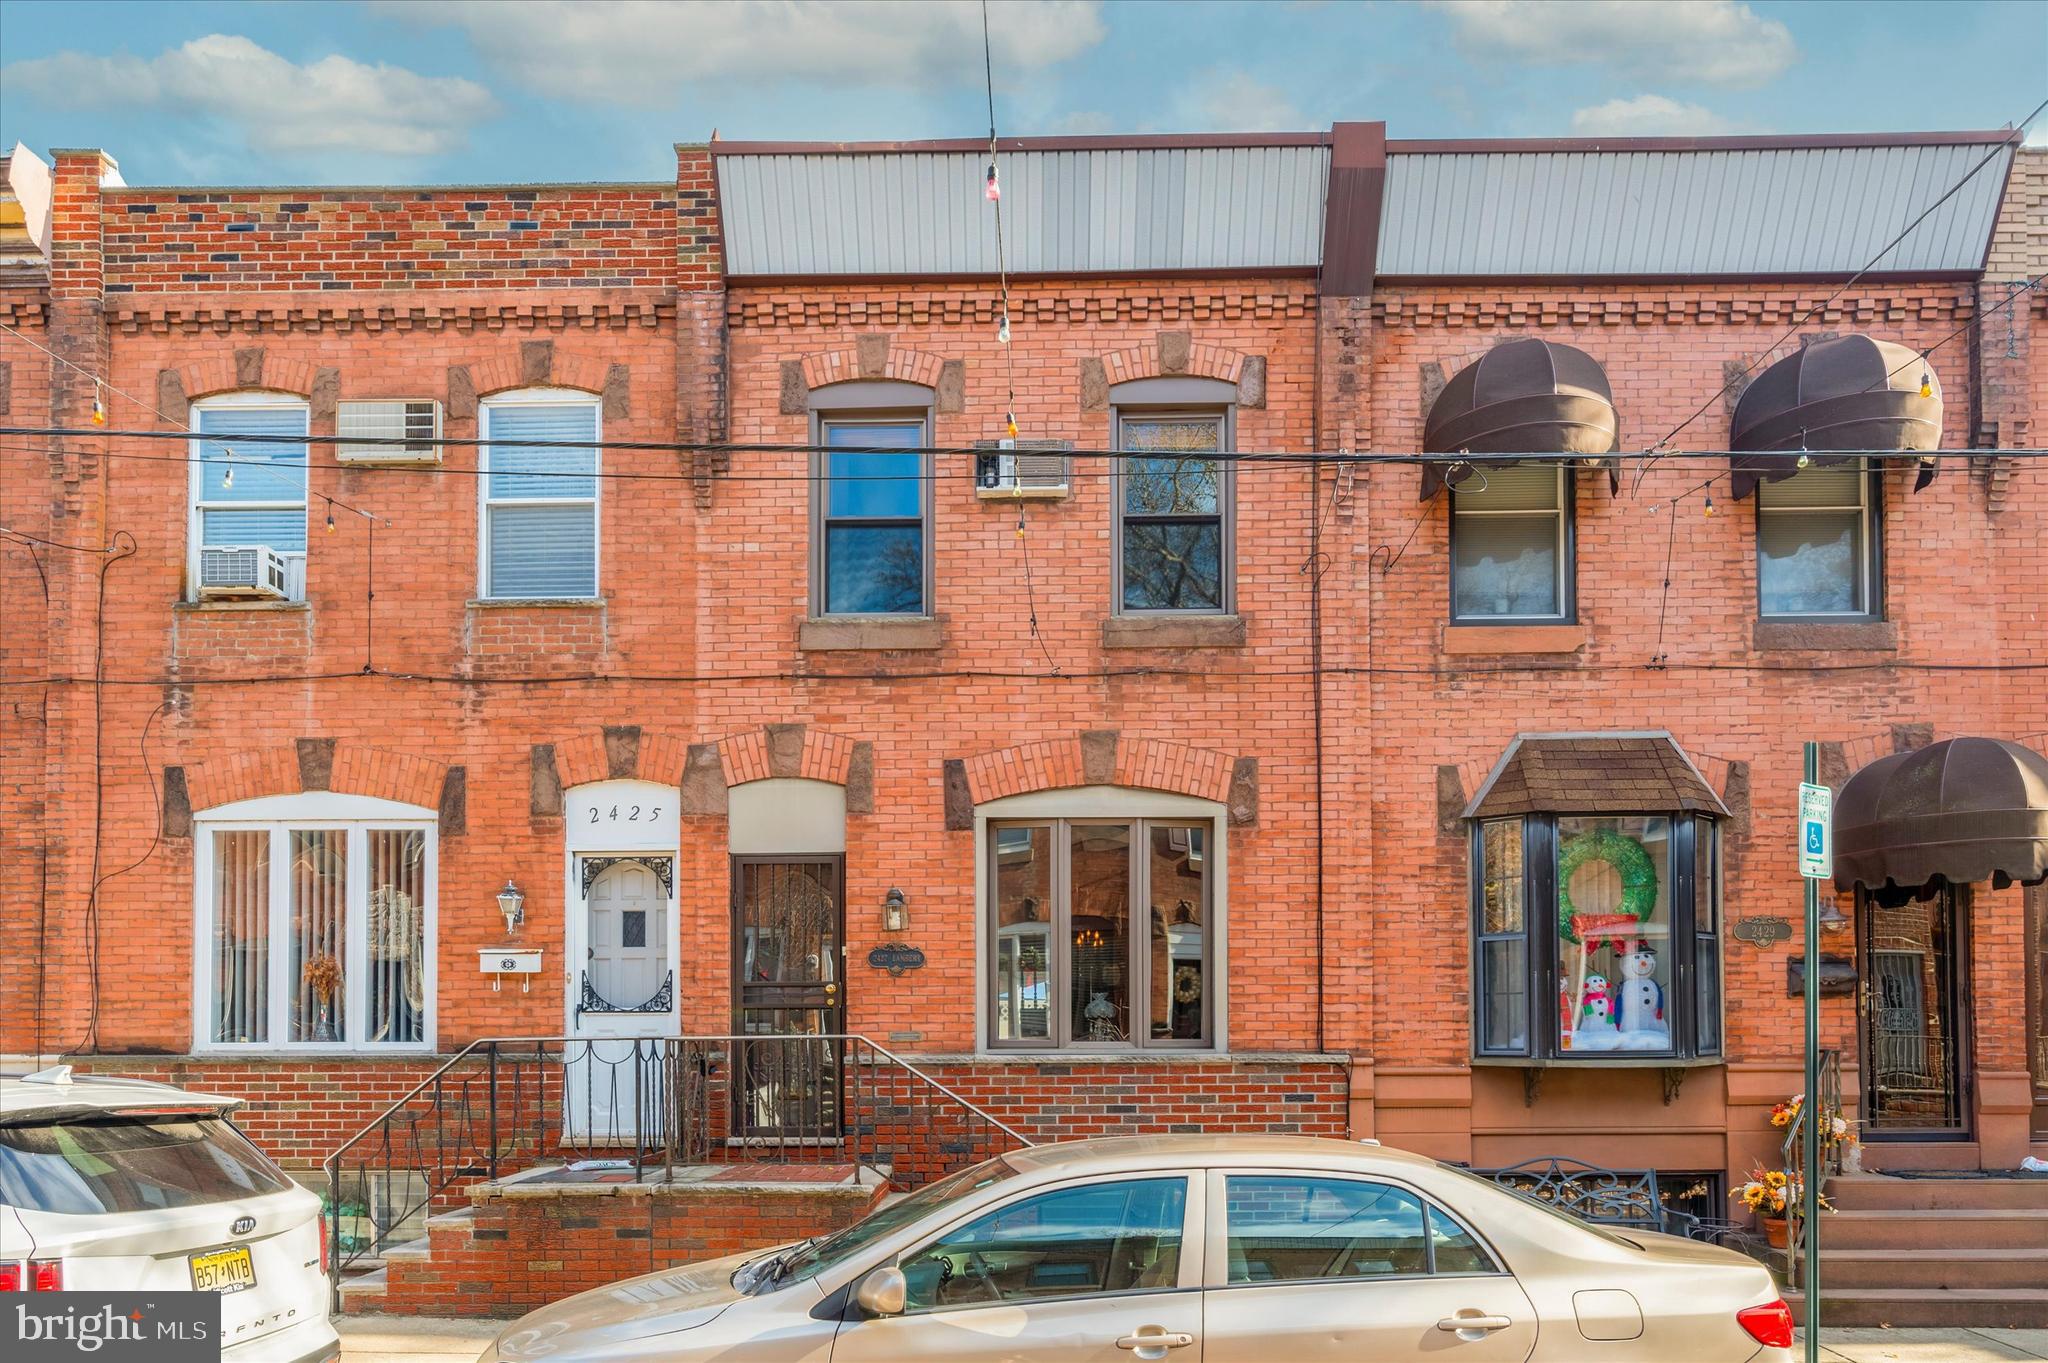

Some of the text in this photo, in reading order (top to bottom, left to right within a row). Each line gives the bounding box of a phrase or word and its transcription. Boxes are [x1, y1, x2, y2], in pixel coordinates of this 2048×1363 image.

[1802, 792, 1828, 806] RESERVED
[589, 805, 661, 823] 2425
[1803, 807, 1826, 822] PARKING
[1751, 925, 1775, 937] 2429
[235, 1219, 255, 1233] KIA
